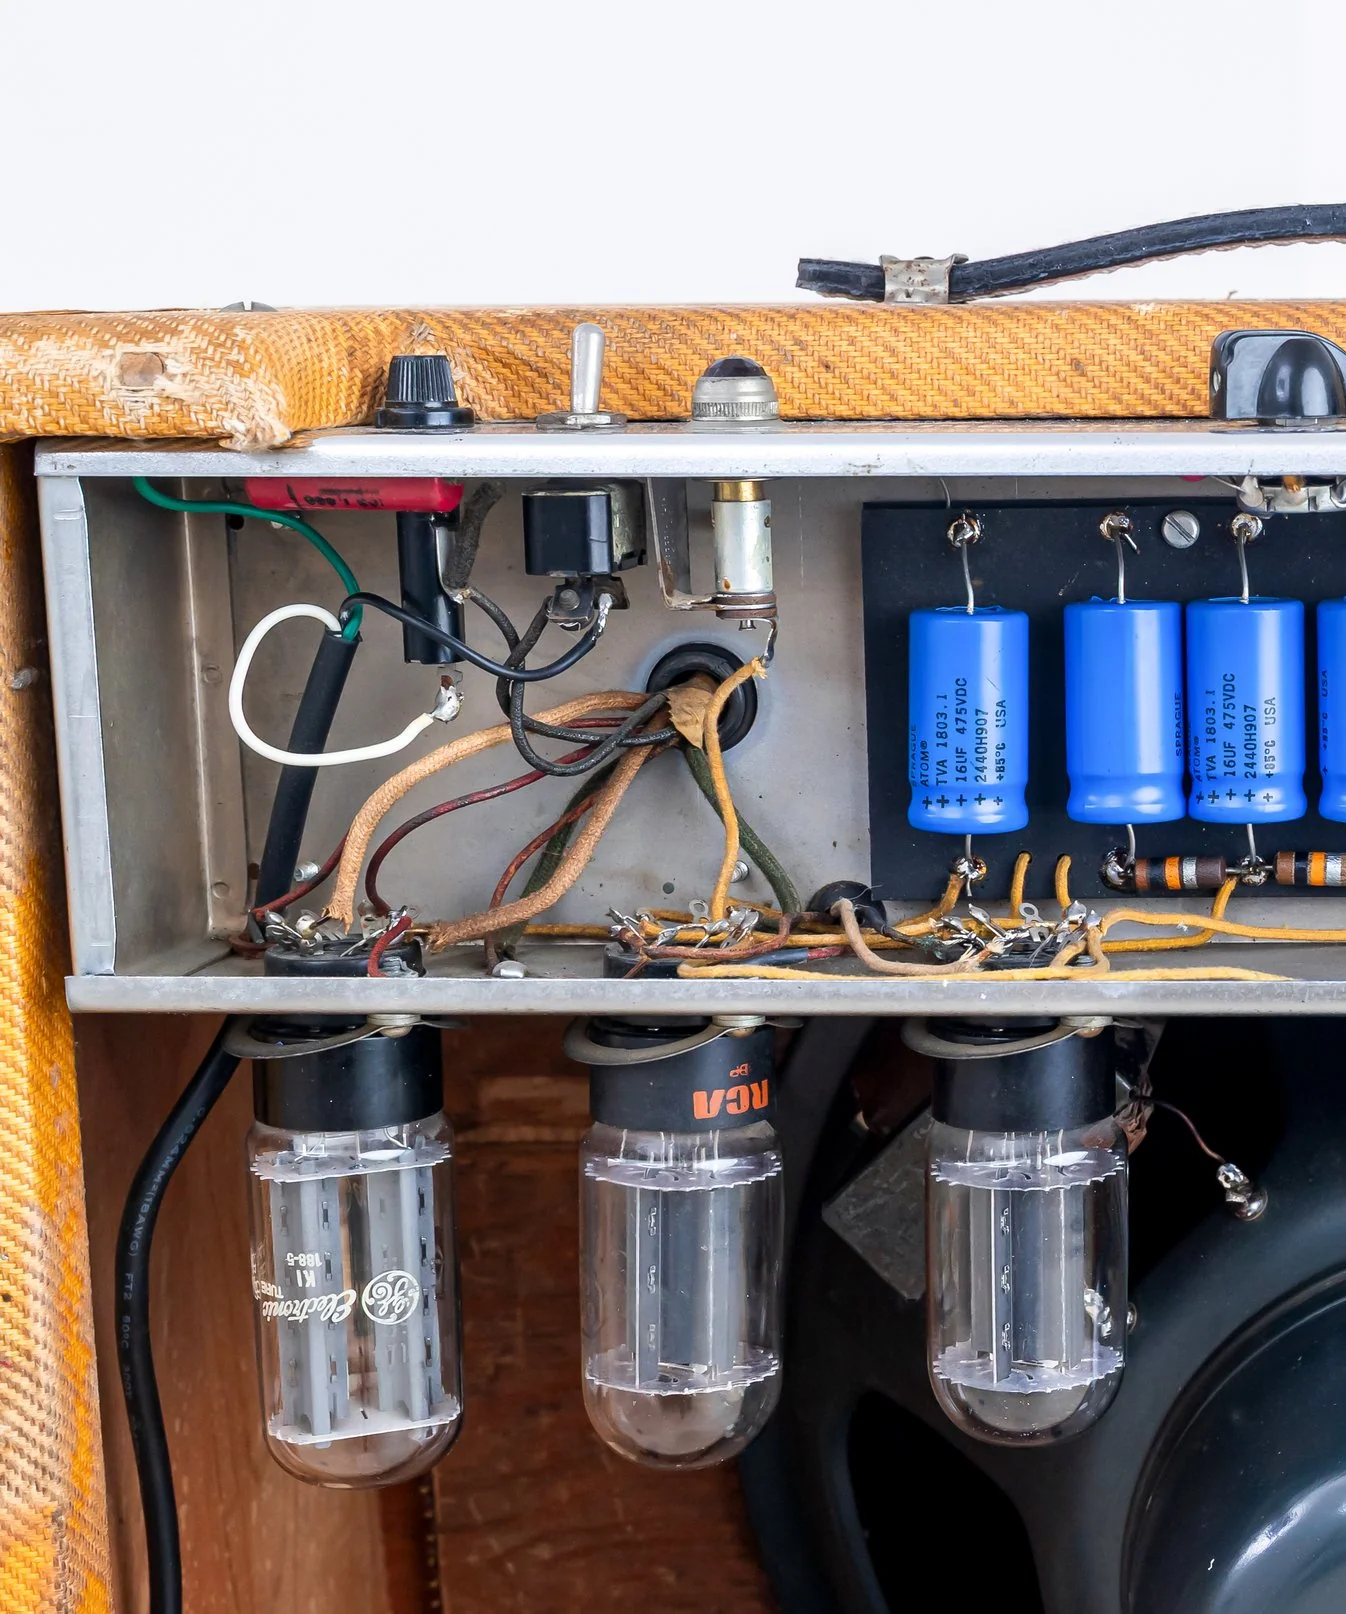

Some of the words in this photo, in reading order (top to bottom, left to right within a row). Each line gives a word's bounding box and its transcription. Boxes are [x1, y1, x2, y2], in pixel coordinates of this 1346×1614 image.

[936, 694, 948, 748] 1803.1
[955, 678, 967, 735] 475VDC
[995, 700, 1006, 728] USA
[1206, 690, 1216, 743] 1803.1
[1223, 673, 1235, 730] 475VDC
[1264, 697, 1276, 725] USA
[1175, 692, 1183, 756] SPRAGUE
[1244, 704, 1257, 779] 2440H907
[956, 747, 967, 782] 16UF
[975, 709, 988, 782] 2440H907
[1223, 742, 1236, 777] 16UF
[936, 760, 948, 785] TVA
[1206, 756, 1217, 781] TVA
[693, 1079, 769, 1120] RCA
[262, 1289, 356, 1323] Electronic
